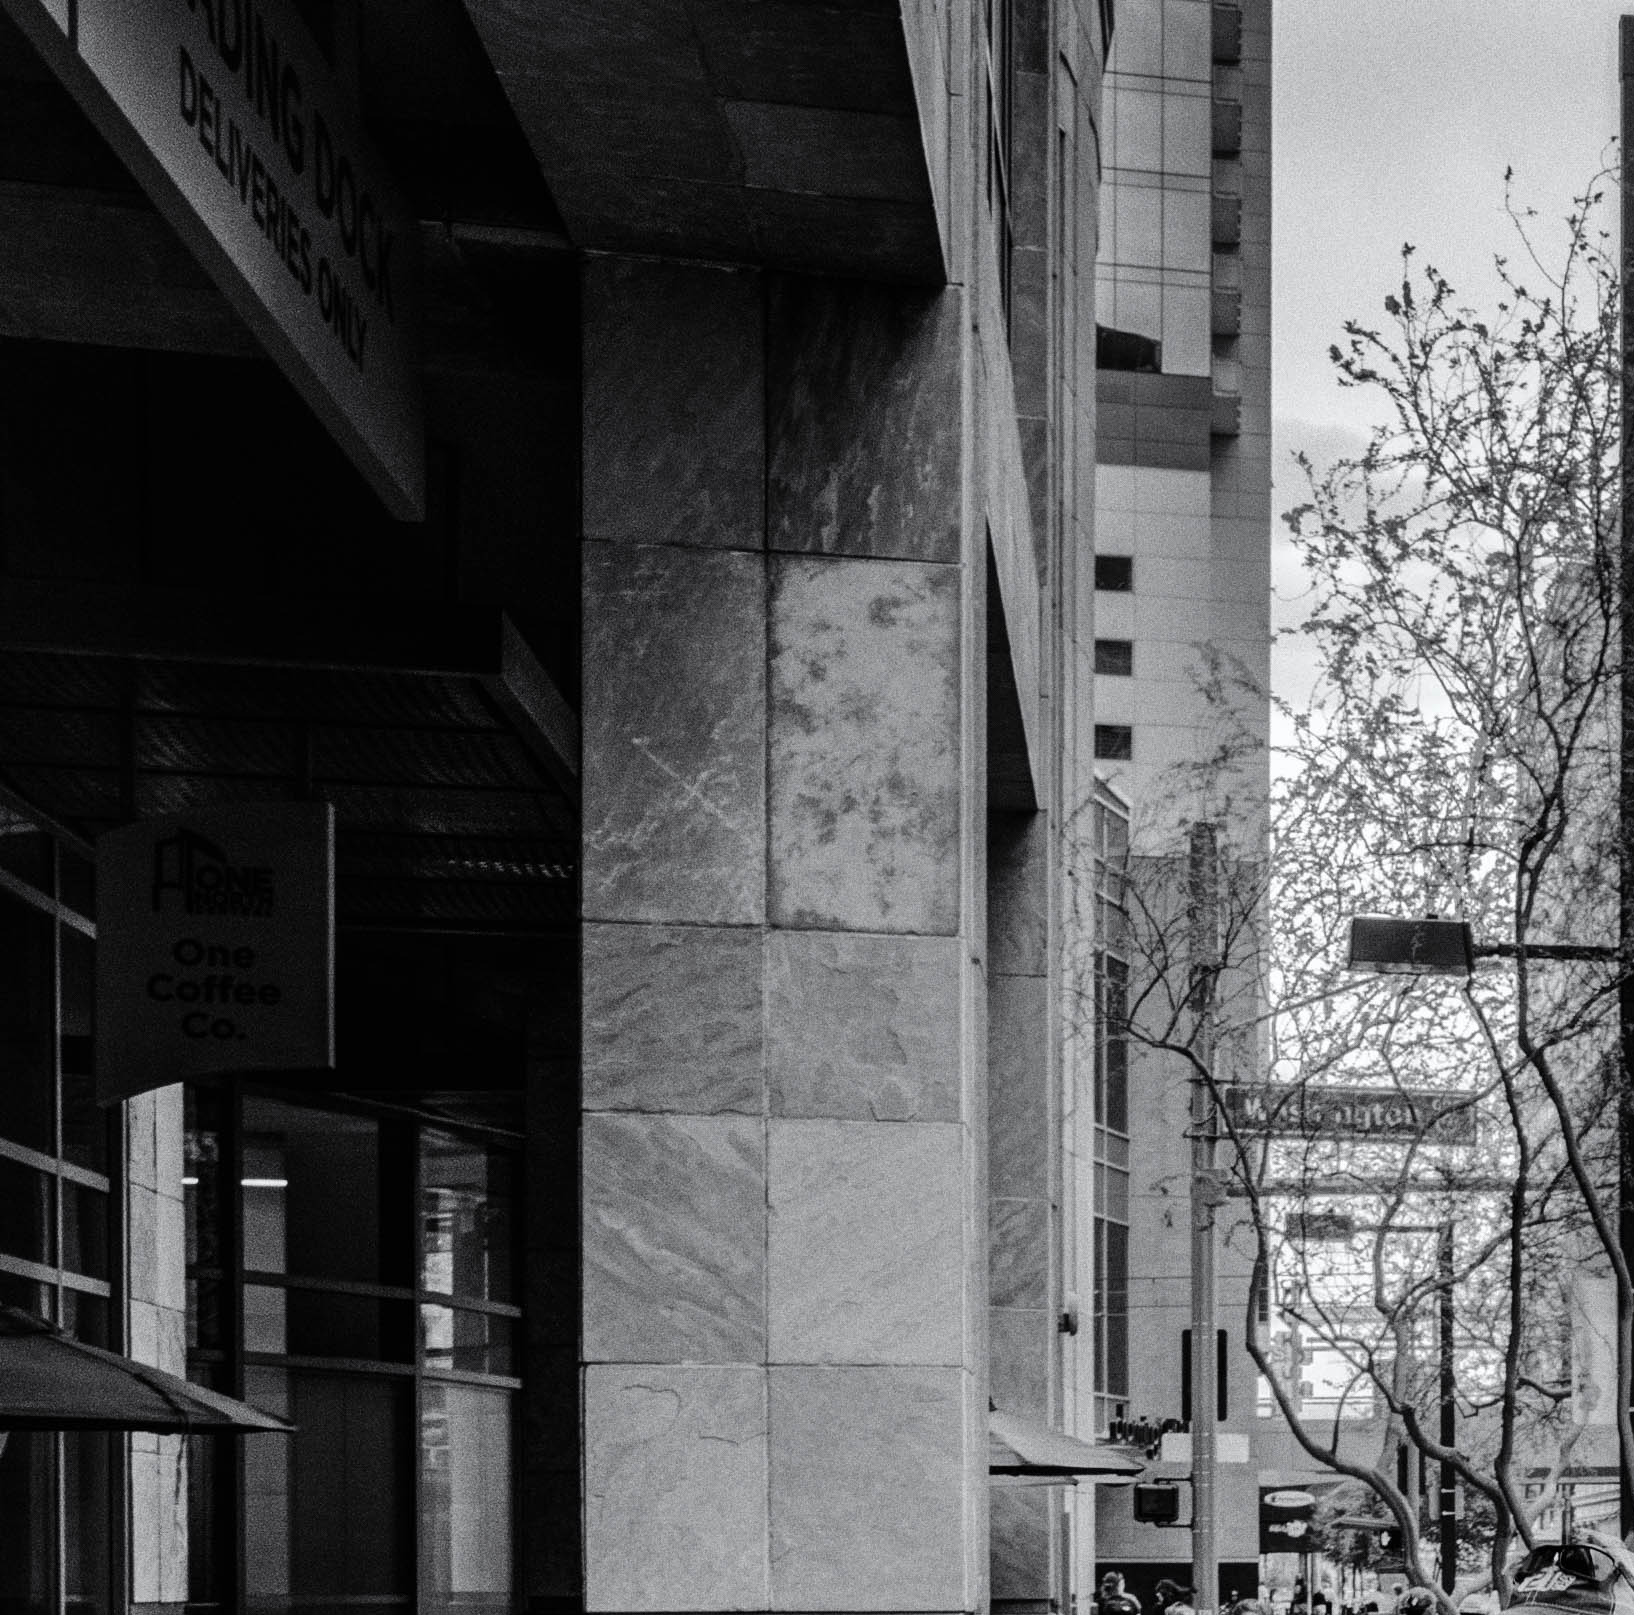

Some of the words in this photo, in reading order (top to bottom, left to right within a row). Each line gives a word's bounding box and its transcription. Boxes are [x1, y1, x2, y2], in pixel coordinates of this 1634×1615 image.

[189, 0, 304, 175] DING
[314, 109, 394, 324] DOCK
[180, 45, 311, 295] DELIVERIES
[318, 258, 366, 372] ONLY
[196, 866, 273, 892] ONE
[173, 938, 255, 968] One
[147, 973, 281, 1005] Coffee
[182, 1012, 246, 1039] Co.
[1244, 1097, 1419, 1131] Wsngton
